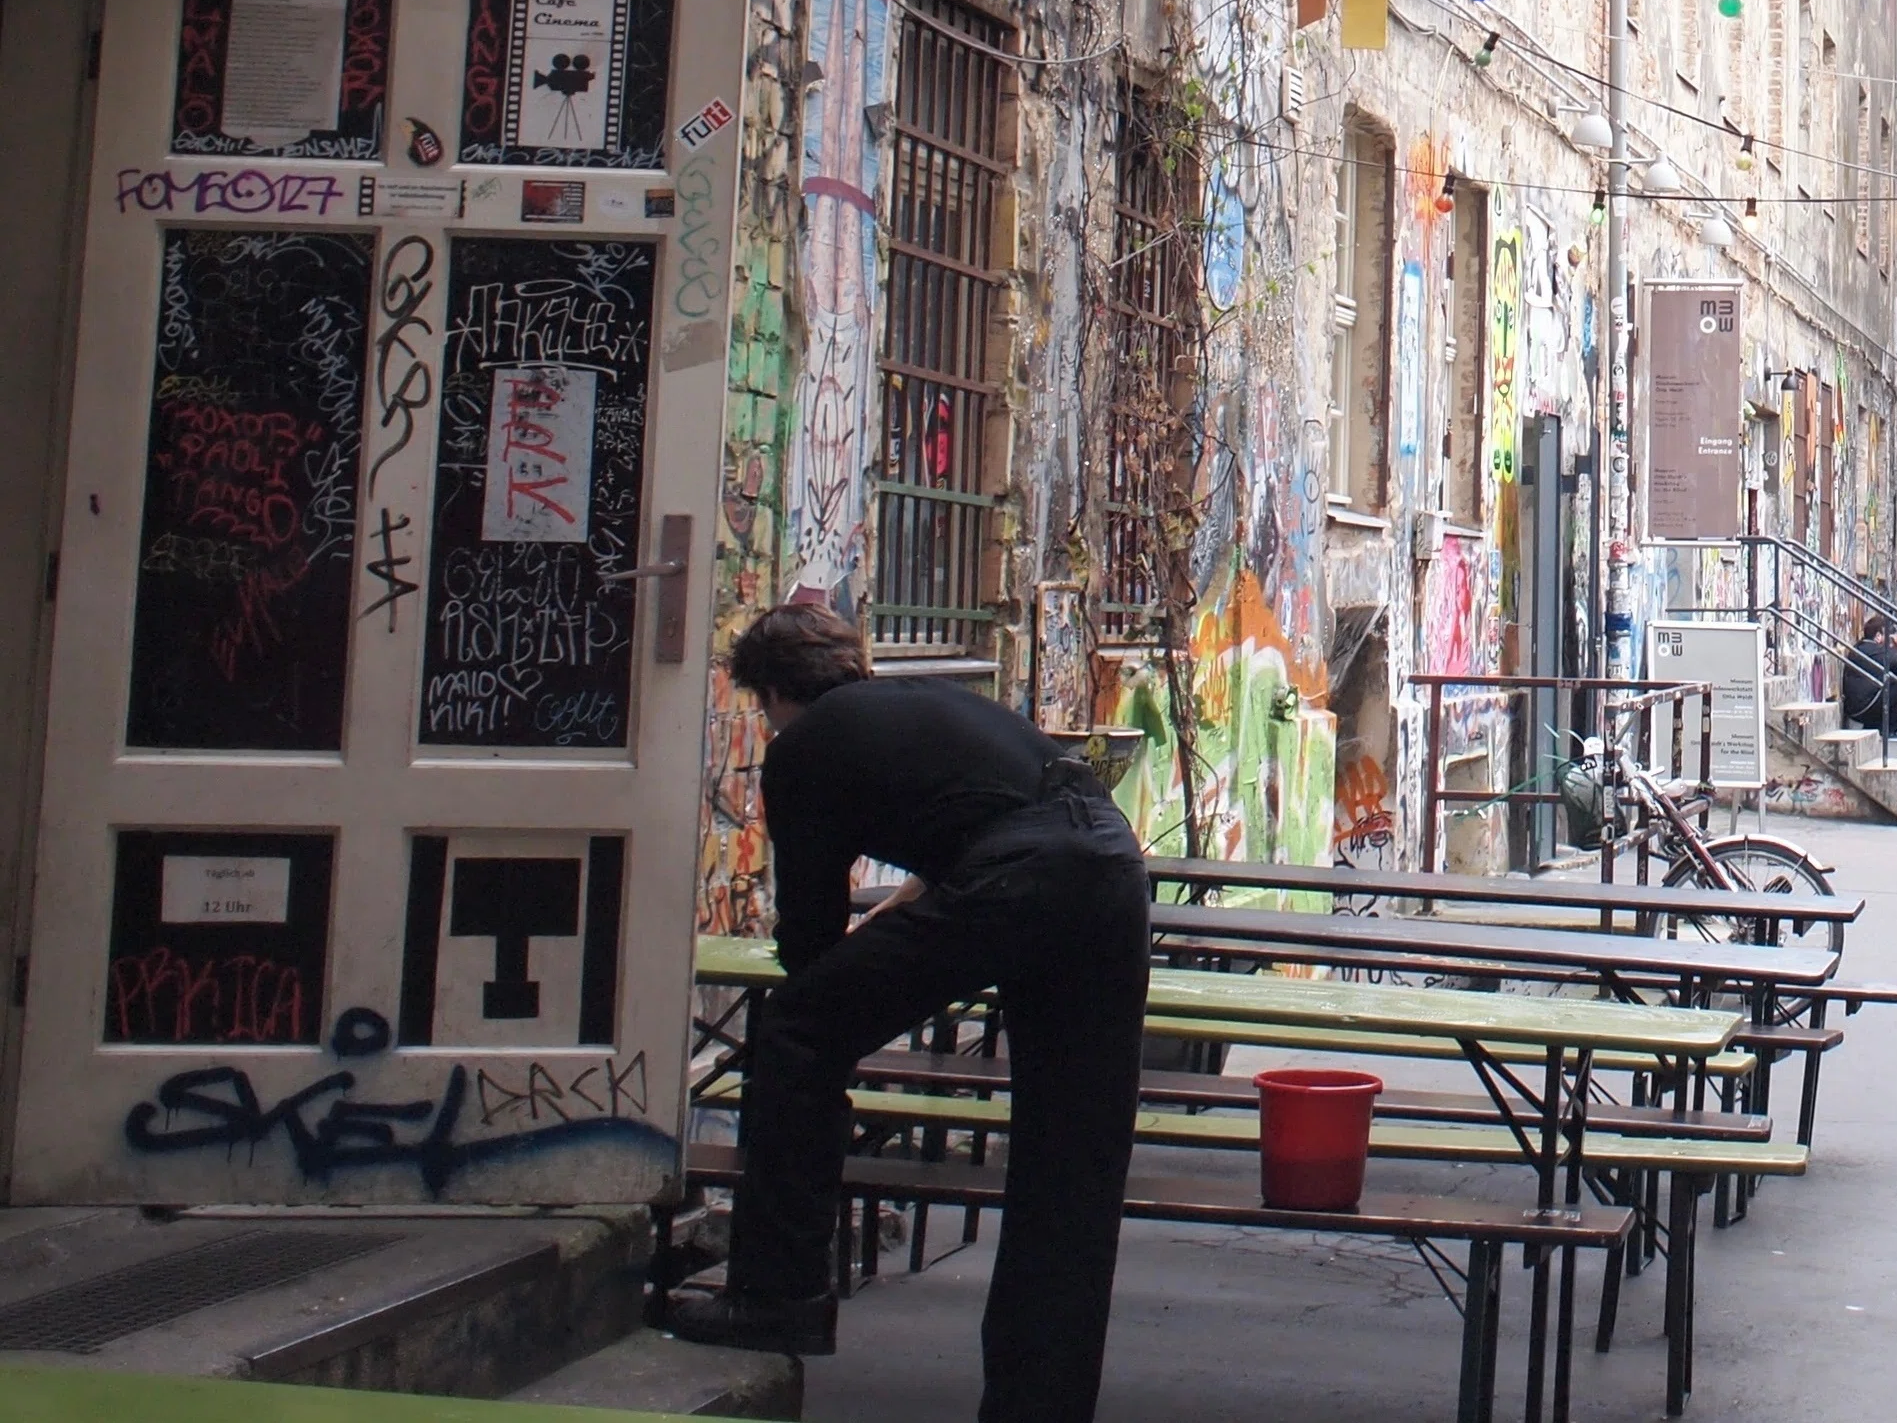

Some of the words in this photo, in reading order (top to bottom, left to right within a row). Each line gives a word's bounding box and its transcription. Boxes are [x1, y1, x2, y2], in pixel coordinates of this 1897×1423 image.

[534, 13, 600, 28] Cinema
[1700, 437, 1733, 446] Eingang
[1698, 446, 1733, 455] Entrance
[203, 901, 221, 913] 12
[225, 901, 252, 913] Uhr
